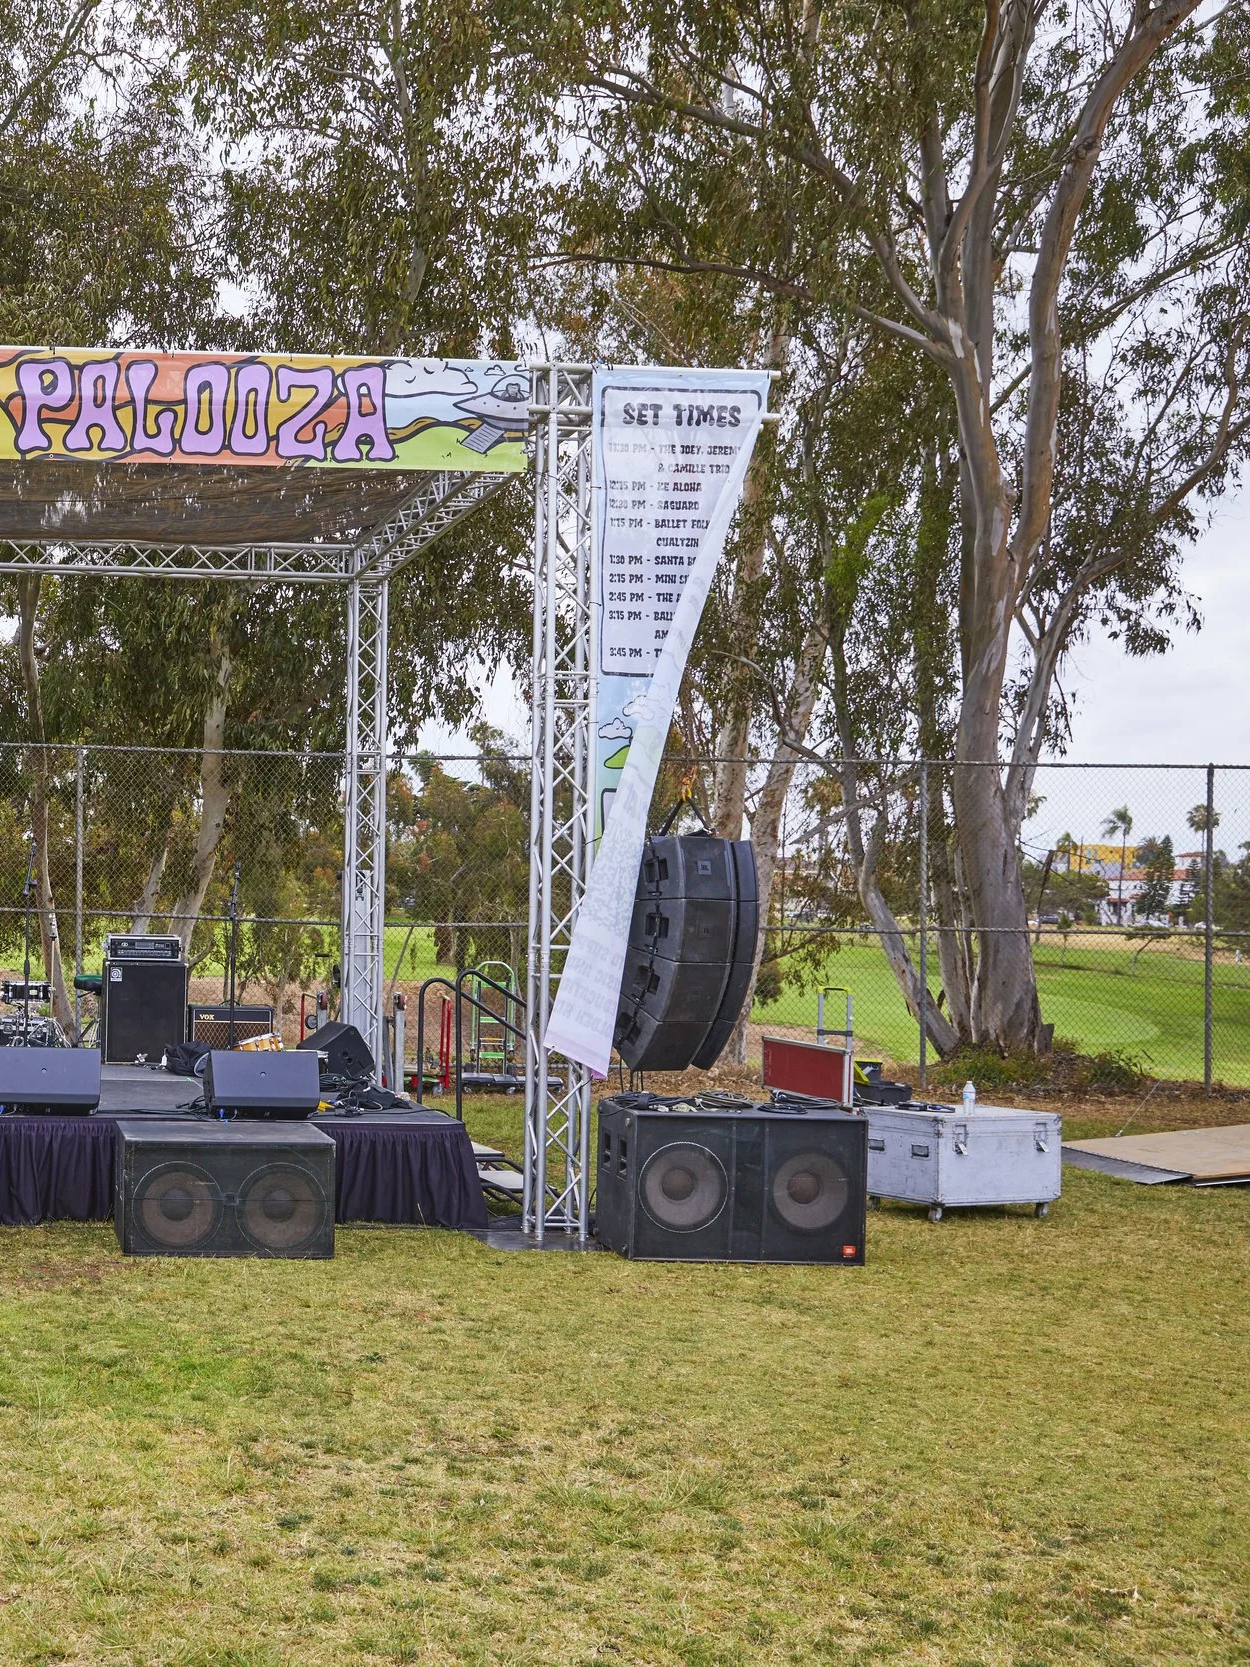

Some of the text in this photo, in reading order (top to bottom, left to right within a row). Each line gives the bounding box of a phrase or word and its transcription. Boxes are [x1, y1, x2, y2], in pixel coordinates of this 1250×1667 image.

[15, 357, 397, 463] PALOOZA
[622, 402, 741, 428] SET TIMES
[632, 443, 647, 453] PM
[658, 443, 676, 454] THE
[707, 445, 741, 456] JEREM
[709, 464, 730, 474] TRIO
[631, 481, 646, 491] PM
[672, 482, 702, 492] ALOHA
[631, 500, 646, 510] PM
[657, 500, 700, 511] SAGUARO
[629, 518, 643, 528] PM
[655, 519, 688, 529] BALLET
[656, 537, 699, 548] CUALTZIN
[609, 554, 625, 565] 1:30
[628, 555, 643, 565] PM
[654, 555, 684, 566] SANTA
[609, 573, 626, 583] 2:15
[628, 574, 643, 584] PM
[655, 574, 676, 585] MINI
[608, 591, 626, 602] 2:45
[629, 592, 644, 602] PM
[656, 592, 673, 603] THE
[608, 610, 624, 620] 3:15
[627, 611, 642, 620] PM
[653, 611, 676, 621] BALL
[609, 647, 626, 657] 3:45
[628, 648, 642, 657] PM
[199, 1013, 215, 1021] VOX
